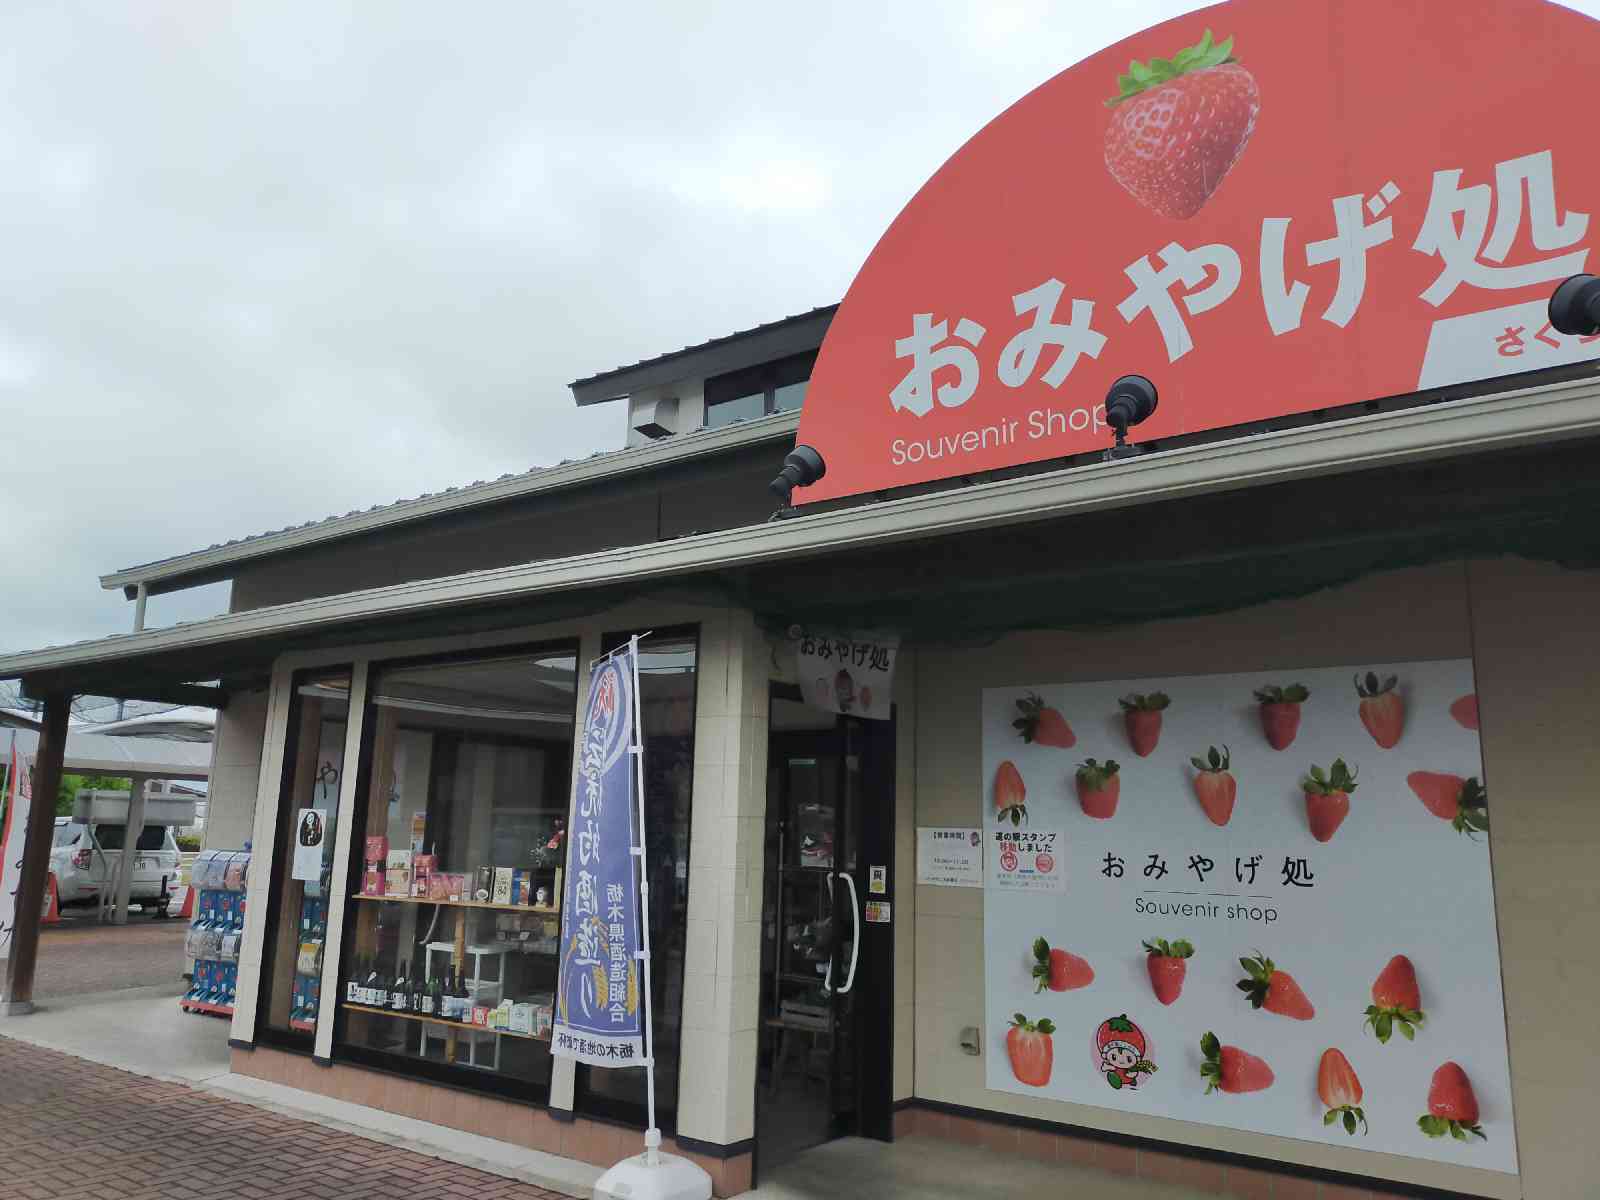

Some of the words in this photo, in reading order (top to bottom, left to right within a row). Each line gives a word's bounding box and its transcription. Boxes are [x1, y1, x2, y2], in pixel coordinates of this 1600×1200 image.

[888, 149, 1591, 418] おみやげ処
[1495, 316, 1600, 357] さく
[892, 417, 1019, 466] Souvenir
[800, 632, 890, 672] おみやげ処
[995, 832, 1057, 842] 道の駅スタンプ
[1101, 851, 1315, 888] おみやげ処
[1135, 897, 1220, 919] Souvenir
[1226, 903, 1278, 924] shop
